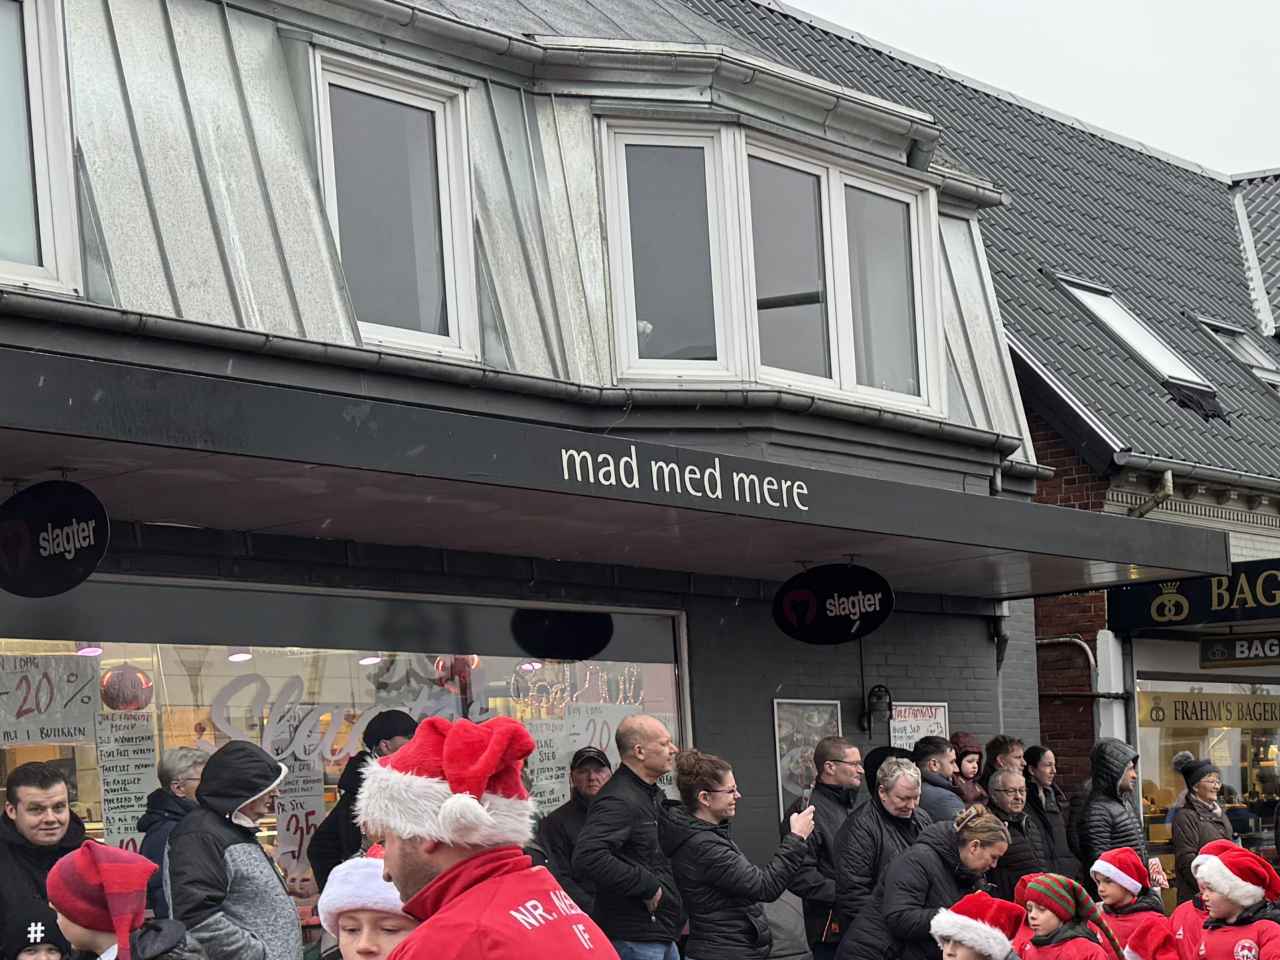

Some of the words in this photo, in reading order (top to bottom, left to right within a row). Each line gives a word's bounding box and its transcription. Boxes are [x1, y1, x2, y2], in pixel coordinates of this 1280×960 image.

[561, 445, 639, 489] mad
[651, 457, 722, 499] med
[733, 471, 808, 510] mere
[39, 518, 96, 560] slagter
[826, 590, 881, 620] slagter
[1174, 700, 1233, 721] FRAHM'S
[40, 726, 86, 740] BUTIKKEN
[509, 899, 558, 930] NR.
[572, 923, 593, 950] IF
